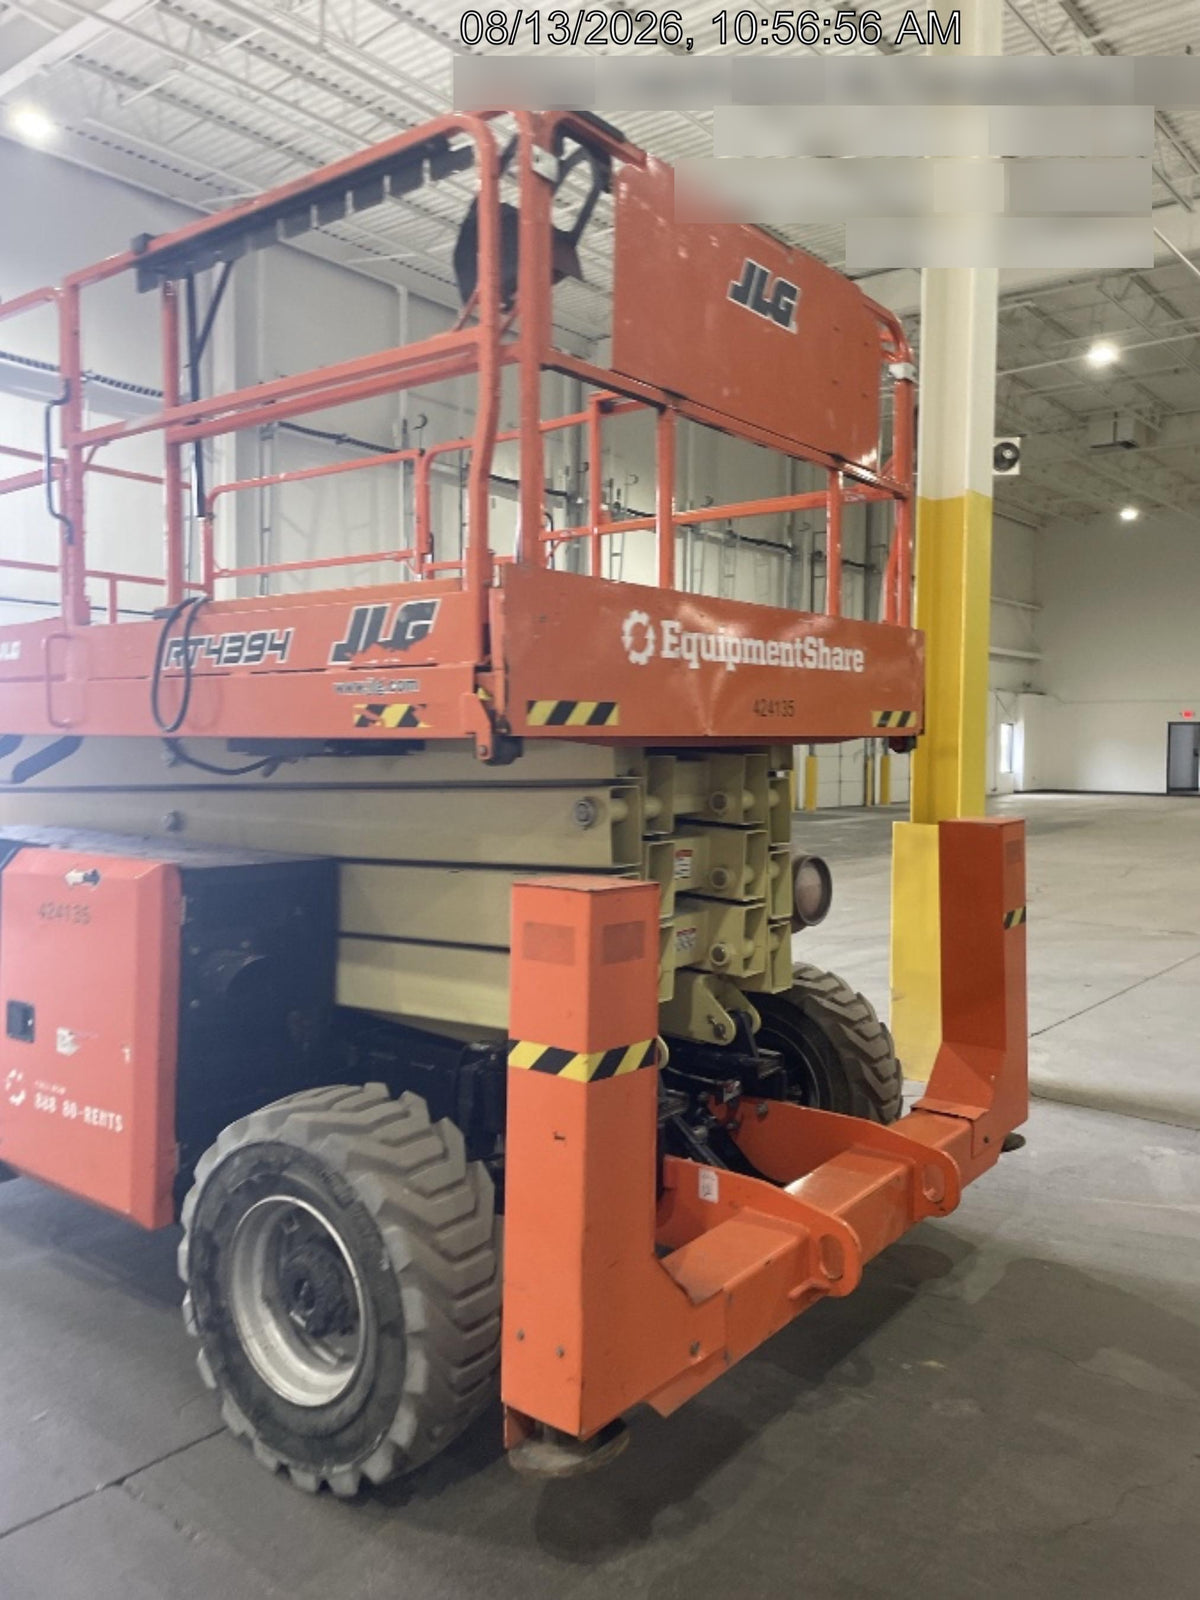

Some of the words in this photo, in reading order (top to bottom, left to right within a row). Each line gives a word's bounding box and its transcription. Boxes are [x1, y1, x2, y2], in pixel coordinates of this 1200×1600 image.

[726, 257, 802, 334] JLG
[161, 627, 295, 670] RT4394
[660, 619, 865, 673] EquipmentShare
[752, 699, 796, 717] 424135
